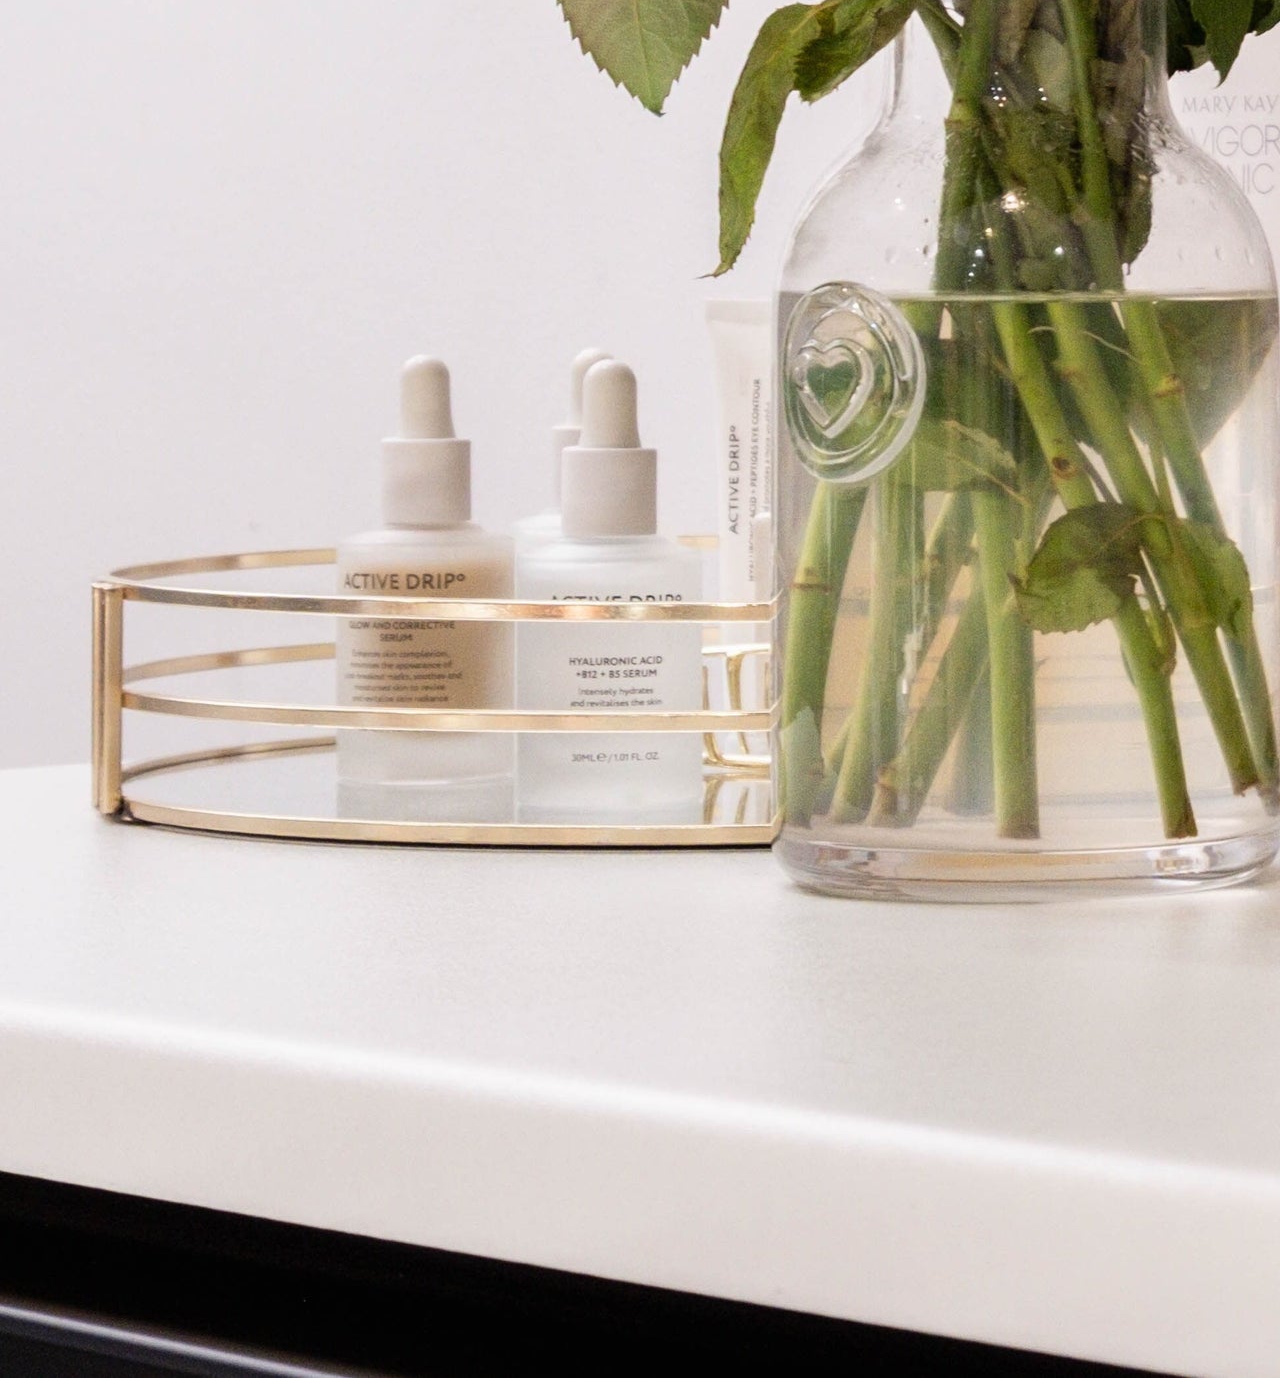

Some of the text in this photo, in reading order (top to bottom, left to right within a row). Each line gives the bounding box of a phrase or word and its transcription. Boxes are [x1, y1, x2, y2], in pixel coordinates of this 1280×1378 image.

[1182, 93, 1280, 115] MARY KAY
[752, 378, 761, 426] CONTOUR
[728, 477, 740, 535] ACTIVE
[344, 573, 400, 591] ACTIVE
[392, 620, 455, 631] CORRECTIVE
[379, 633, 413, 642] SERUM
[568, 655, 663, 668] HYALURONIC ACID
[622, 668, 658, 678] SERUM
[618, 686, 654, 698] hydrates
[630, 697, 645, 708] the
[646, 697, 663, 707] skin
